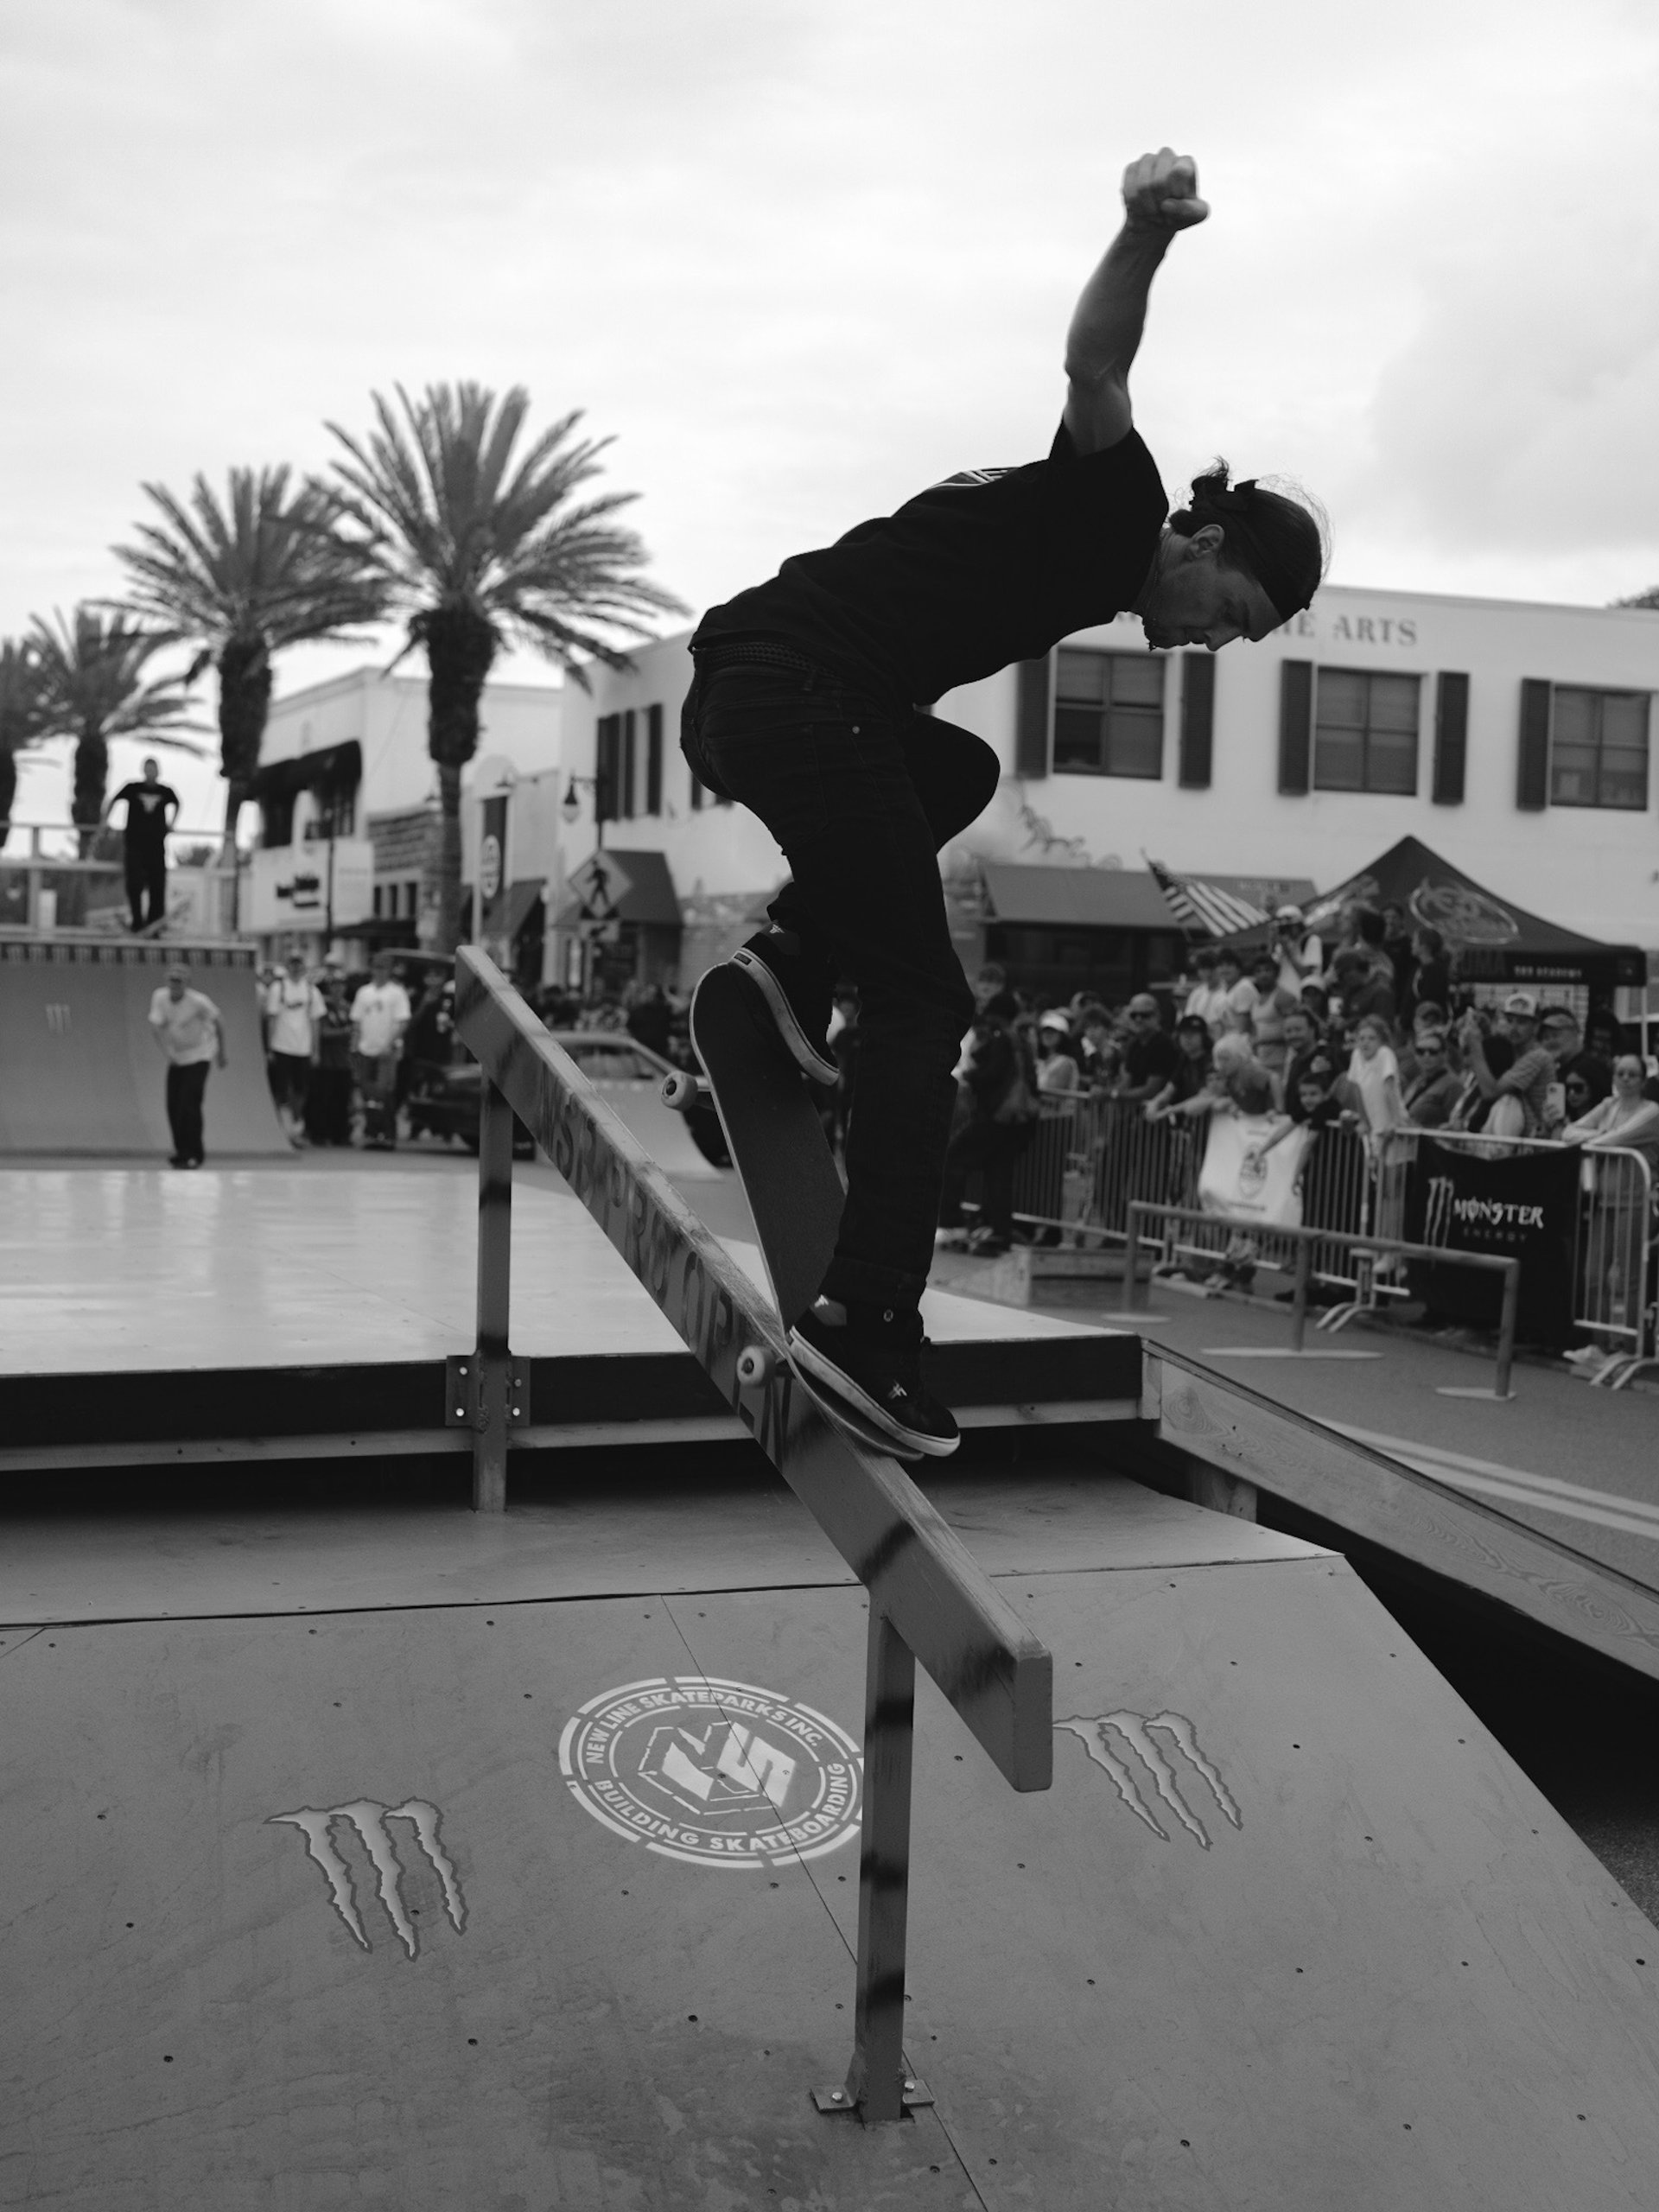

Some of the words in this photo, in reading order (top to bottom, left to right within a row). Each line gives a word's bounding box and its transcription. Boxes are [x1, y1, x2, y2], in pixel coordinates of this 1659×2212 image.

[1332, 614, 1417, 646] ARTS
[1453, 1197, 1544, 1229] MONSTER
[586, 1726, 609, 1764] NEW
[607, 1700, 639, 1729] LINE
[643, 1691, 785, 1721] SKATEPARKS
[785, 1716, 823, 1747] INC.
[594, 1780, 699, 1847] BUILDING
[710, 1763, 847, 1852] SKATEBOARDING
